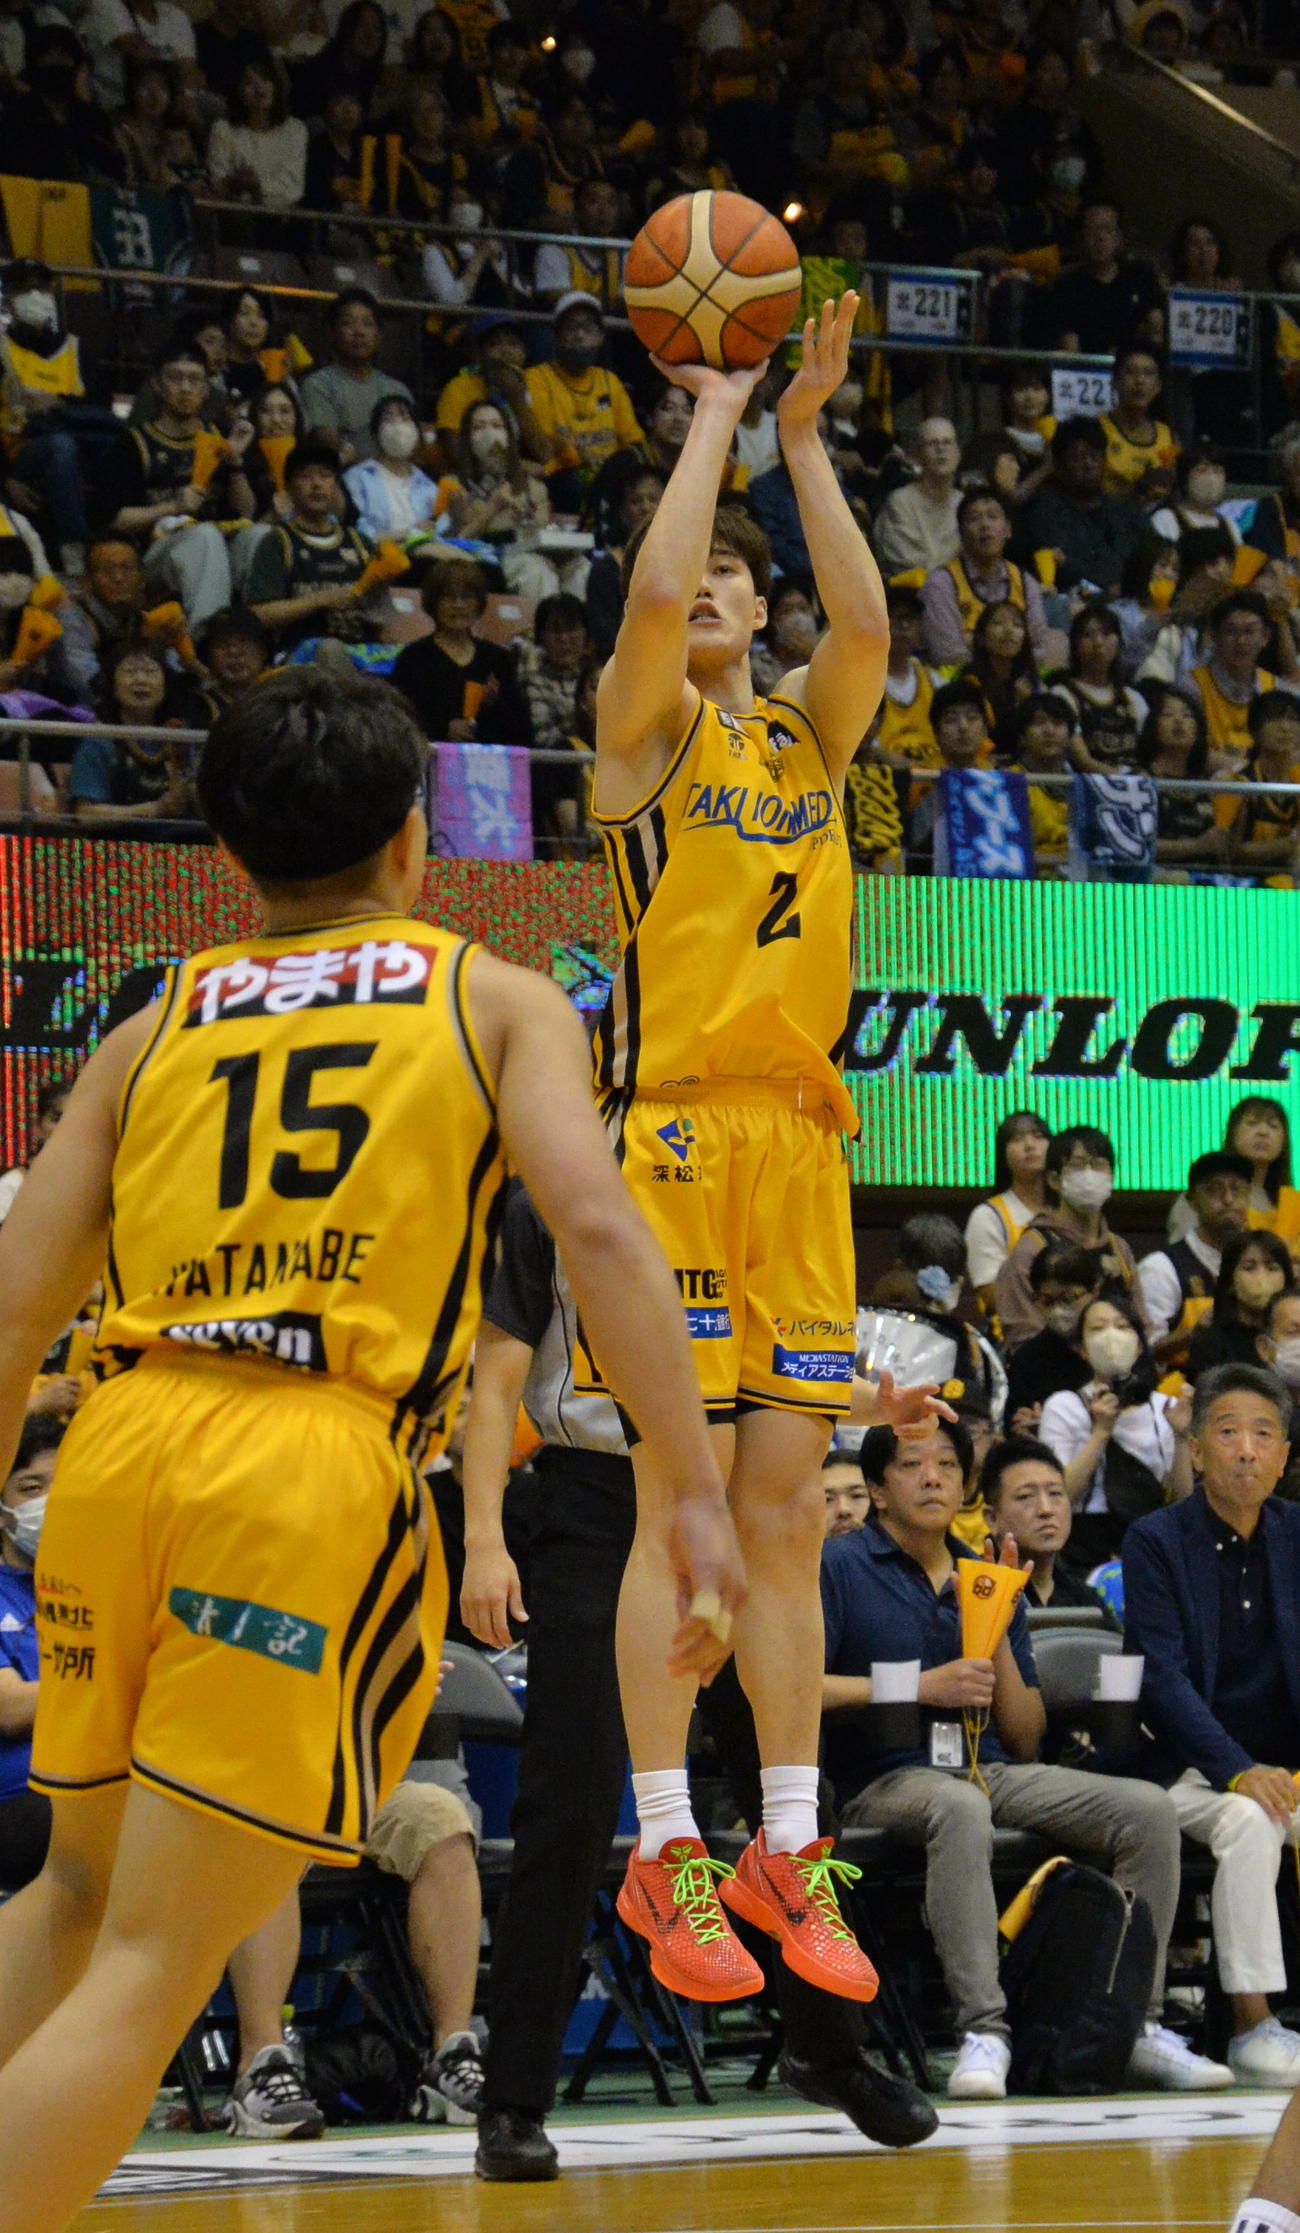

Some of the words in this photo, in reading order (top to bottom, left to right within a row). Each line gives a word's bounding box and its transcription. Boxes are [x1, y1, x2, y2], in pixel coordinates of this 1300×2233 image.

[914, 288, 950, 318] 221
[1195, 306, 1233, 336] 220
[757, 871, 801, 948] 2
[196, 941, 428, 1026] やまや
[208, 1040, 379, 1210] 15
[152, 1228, 375, 1298] ATANABE
